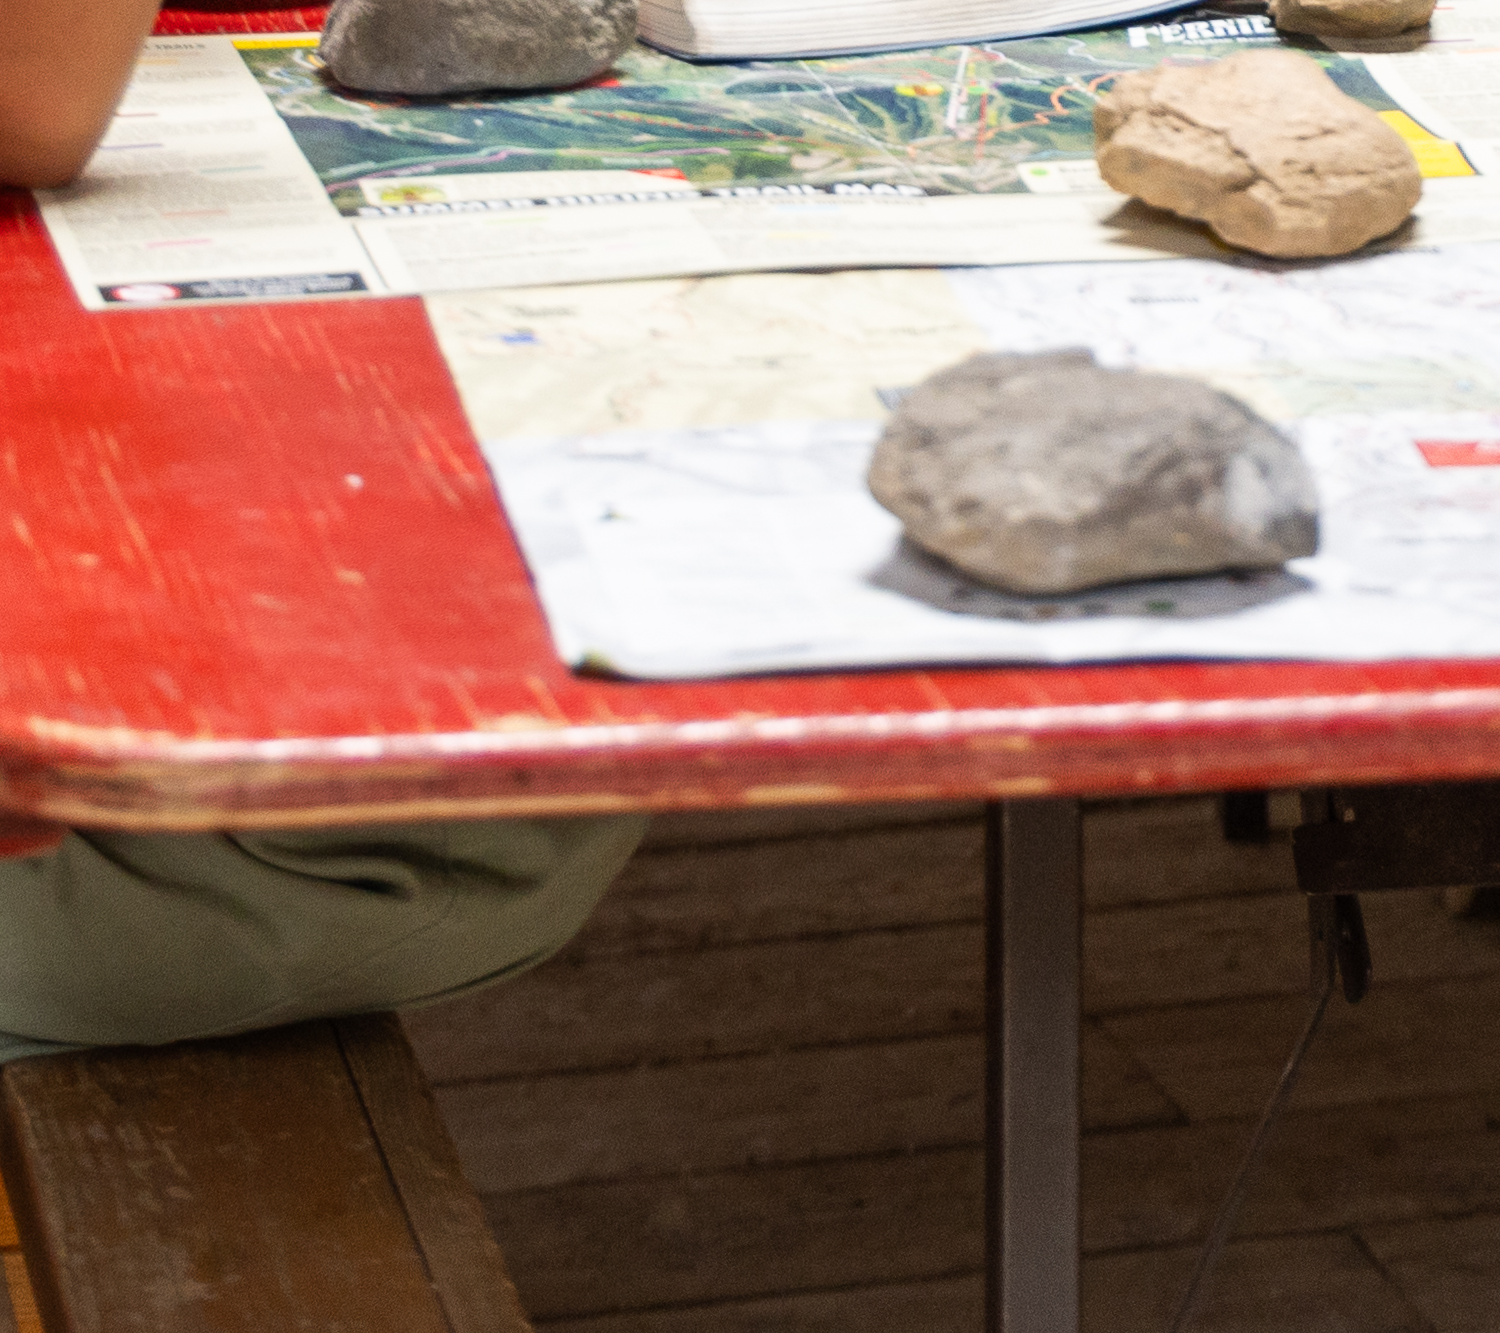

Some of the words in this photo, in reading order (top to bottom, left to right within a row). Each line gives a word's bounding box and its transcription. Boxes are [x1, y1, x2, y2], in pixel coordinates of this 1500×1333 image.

[1126, 14, 1278, 49] FERNIE
[356, 196, 536, 219] SUMMER
[712, 182, 820, 200] TRAIL
[831, 180, 928, 199] MAP
